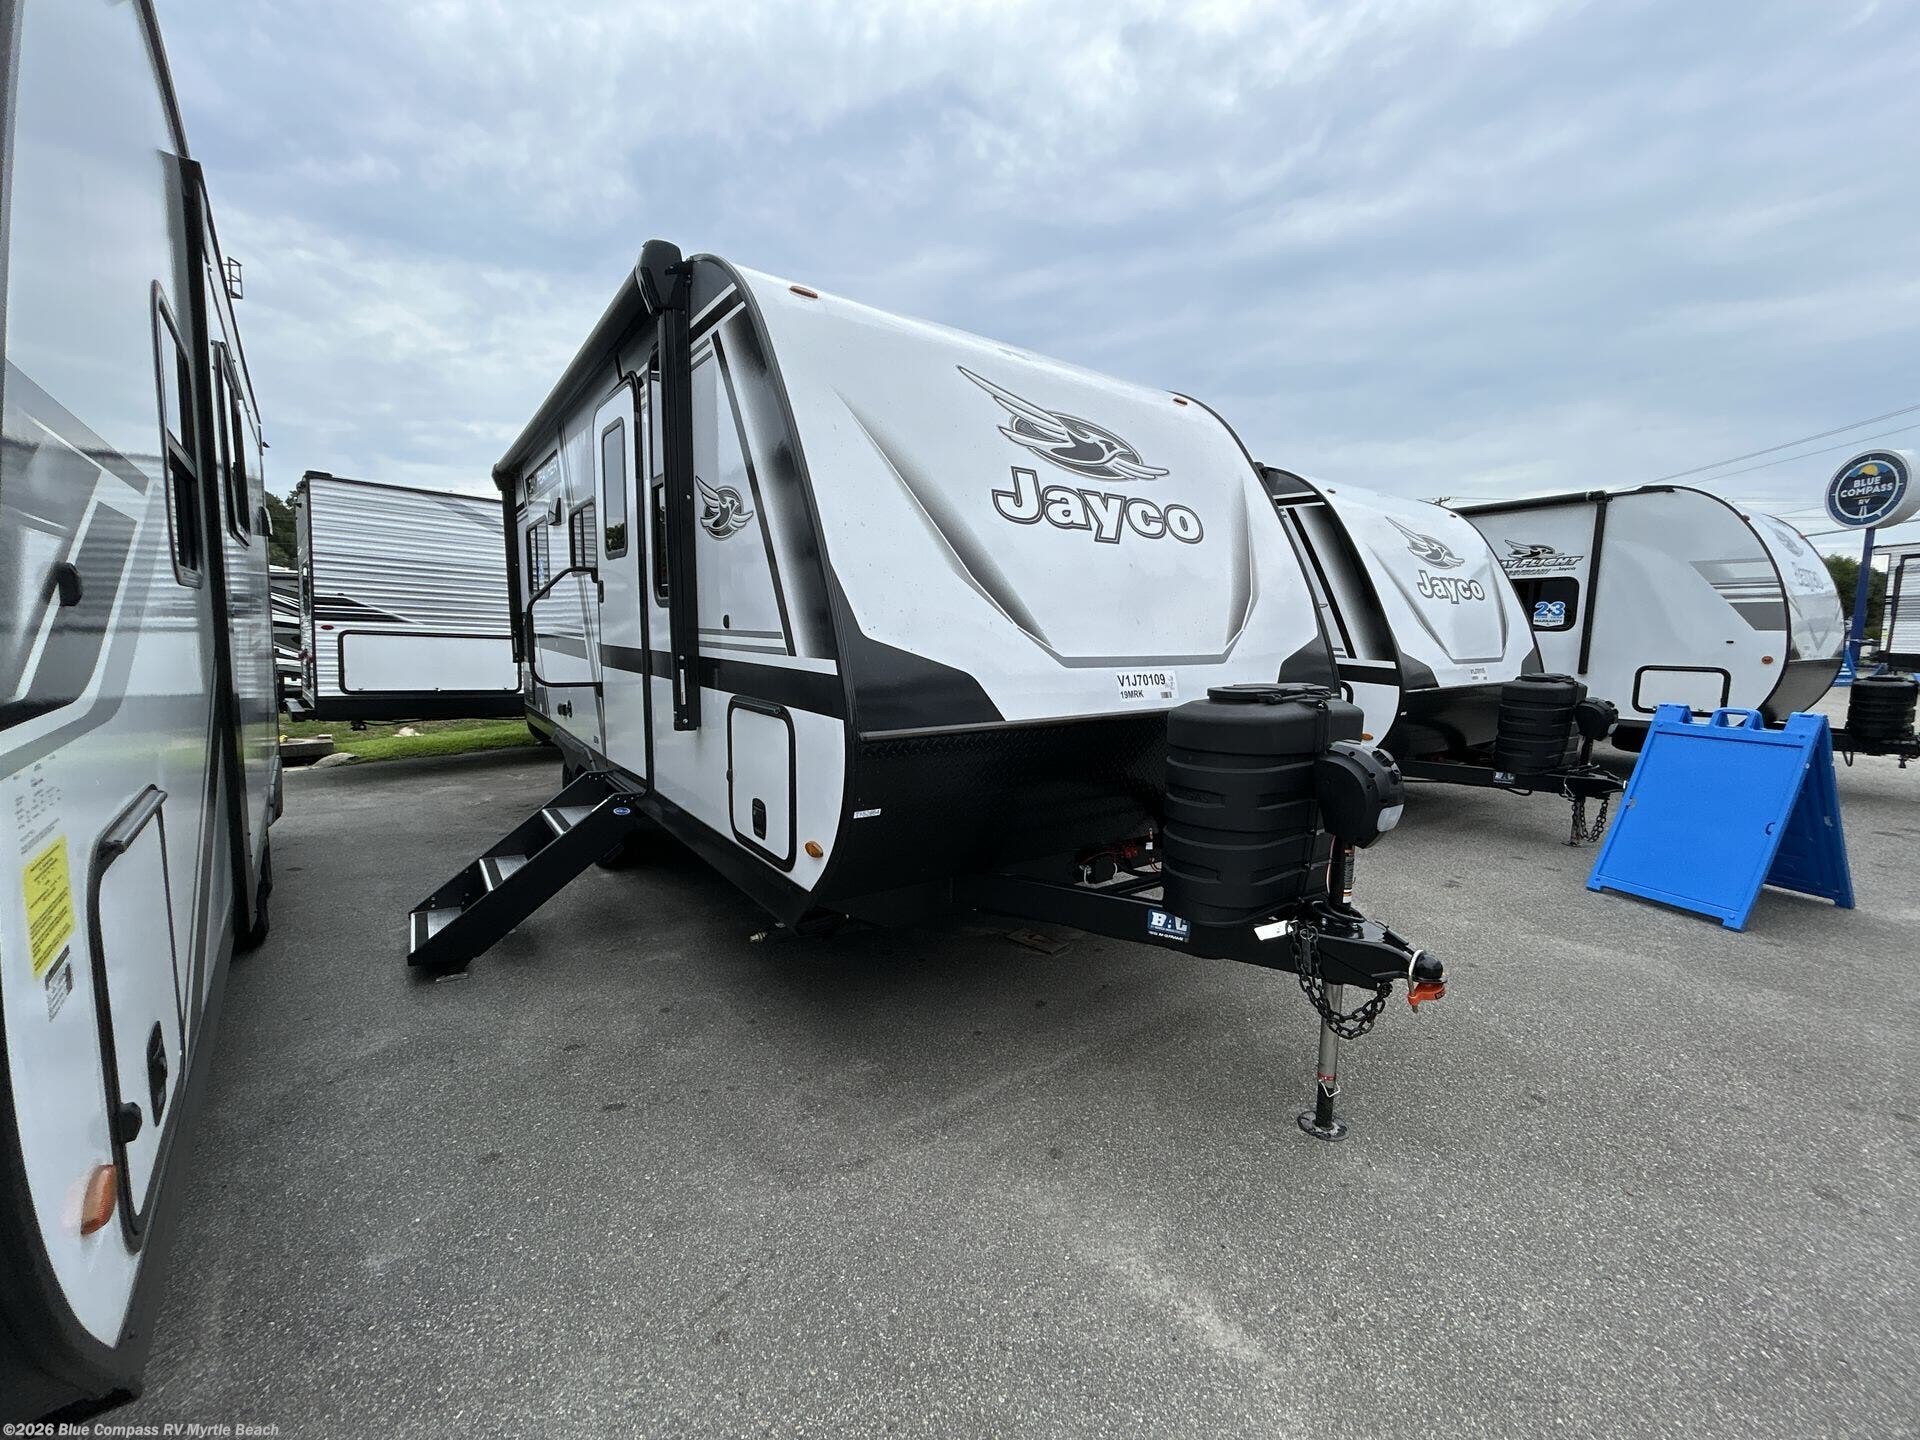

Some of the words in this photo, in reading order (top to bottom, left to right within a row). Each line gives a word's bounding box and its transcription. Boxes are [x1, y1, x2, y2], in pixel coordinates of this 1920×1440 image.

[1853, 476, 1882, 488] BLUE
[1840, 482, 1894, 498] COMPASS
[991, 466, 1204, 545] Jayco
[1857, 497, 1871, 505] RV
[1519, 556, 1584, 568] FLIGHT
[1416, 569, 1485, 605] Jayco
[1117, 673, 1166, 687] V1J70109
[1120, 689, 1144, 699] 19MRK
